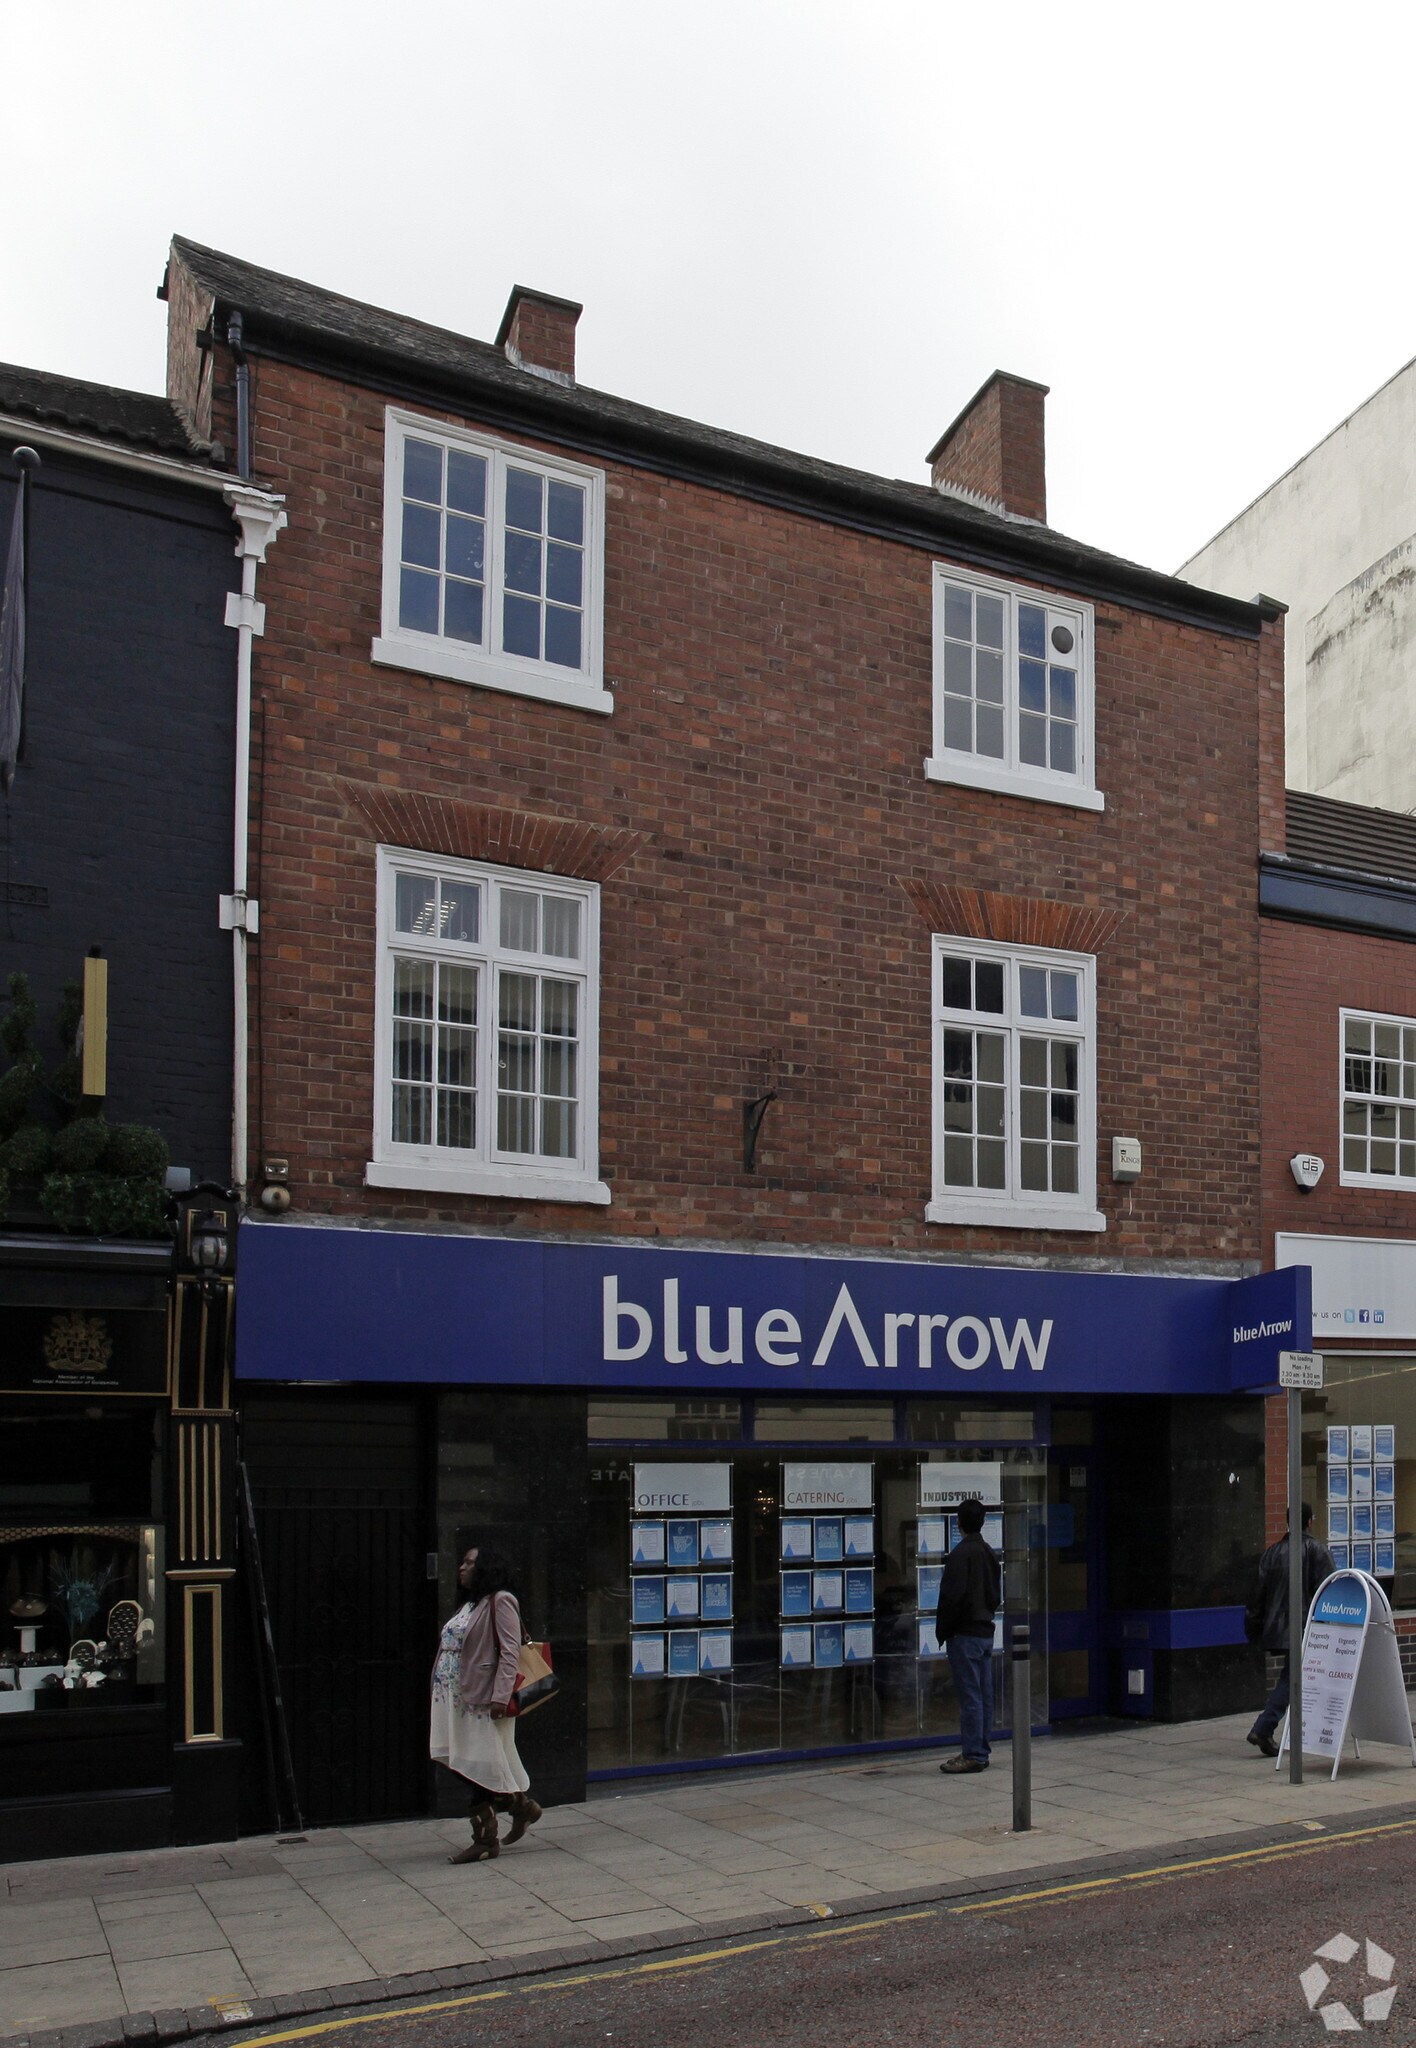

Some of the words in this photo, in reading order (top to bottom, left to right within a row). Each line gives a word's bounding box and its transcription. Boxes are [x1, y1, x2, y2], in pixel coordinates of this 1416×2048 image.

[1120, 1155, 1140, 1164] KINGS
[1297, 1355, 1313, 1363] loading
[638, 1494, 690, 1506] OFFICE
[787, 1492, 845, 1504] CATERING
[923, 1491, 984, 1502] INDUSTRIAL
[1310, 1632, 1329, 1641] Urgently
[1307, 1641, 1329, 1650] Required
[1338, 1637, 1357, 1646] Urgently
[1335, 1647, 1356, 1656] Required
[1328, 1670, 1354, 1680] CLEANERS
